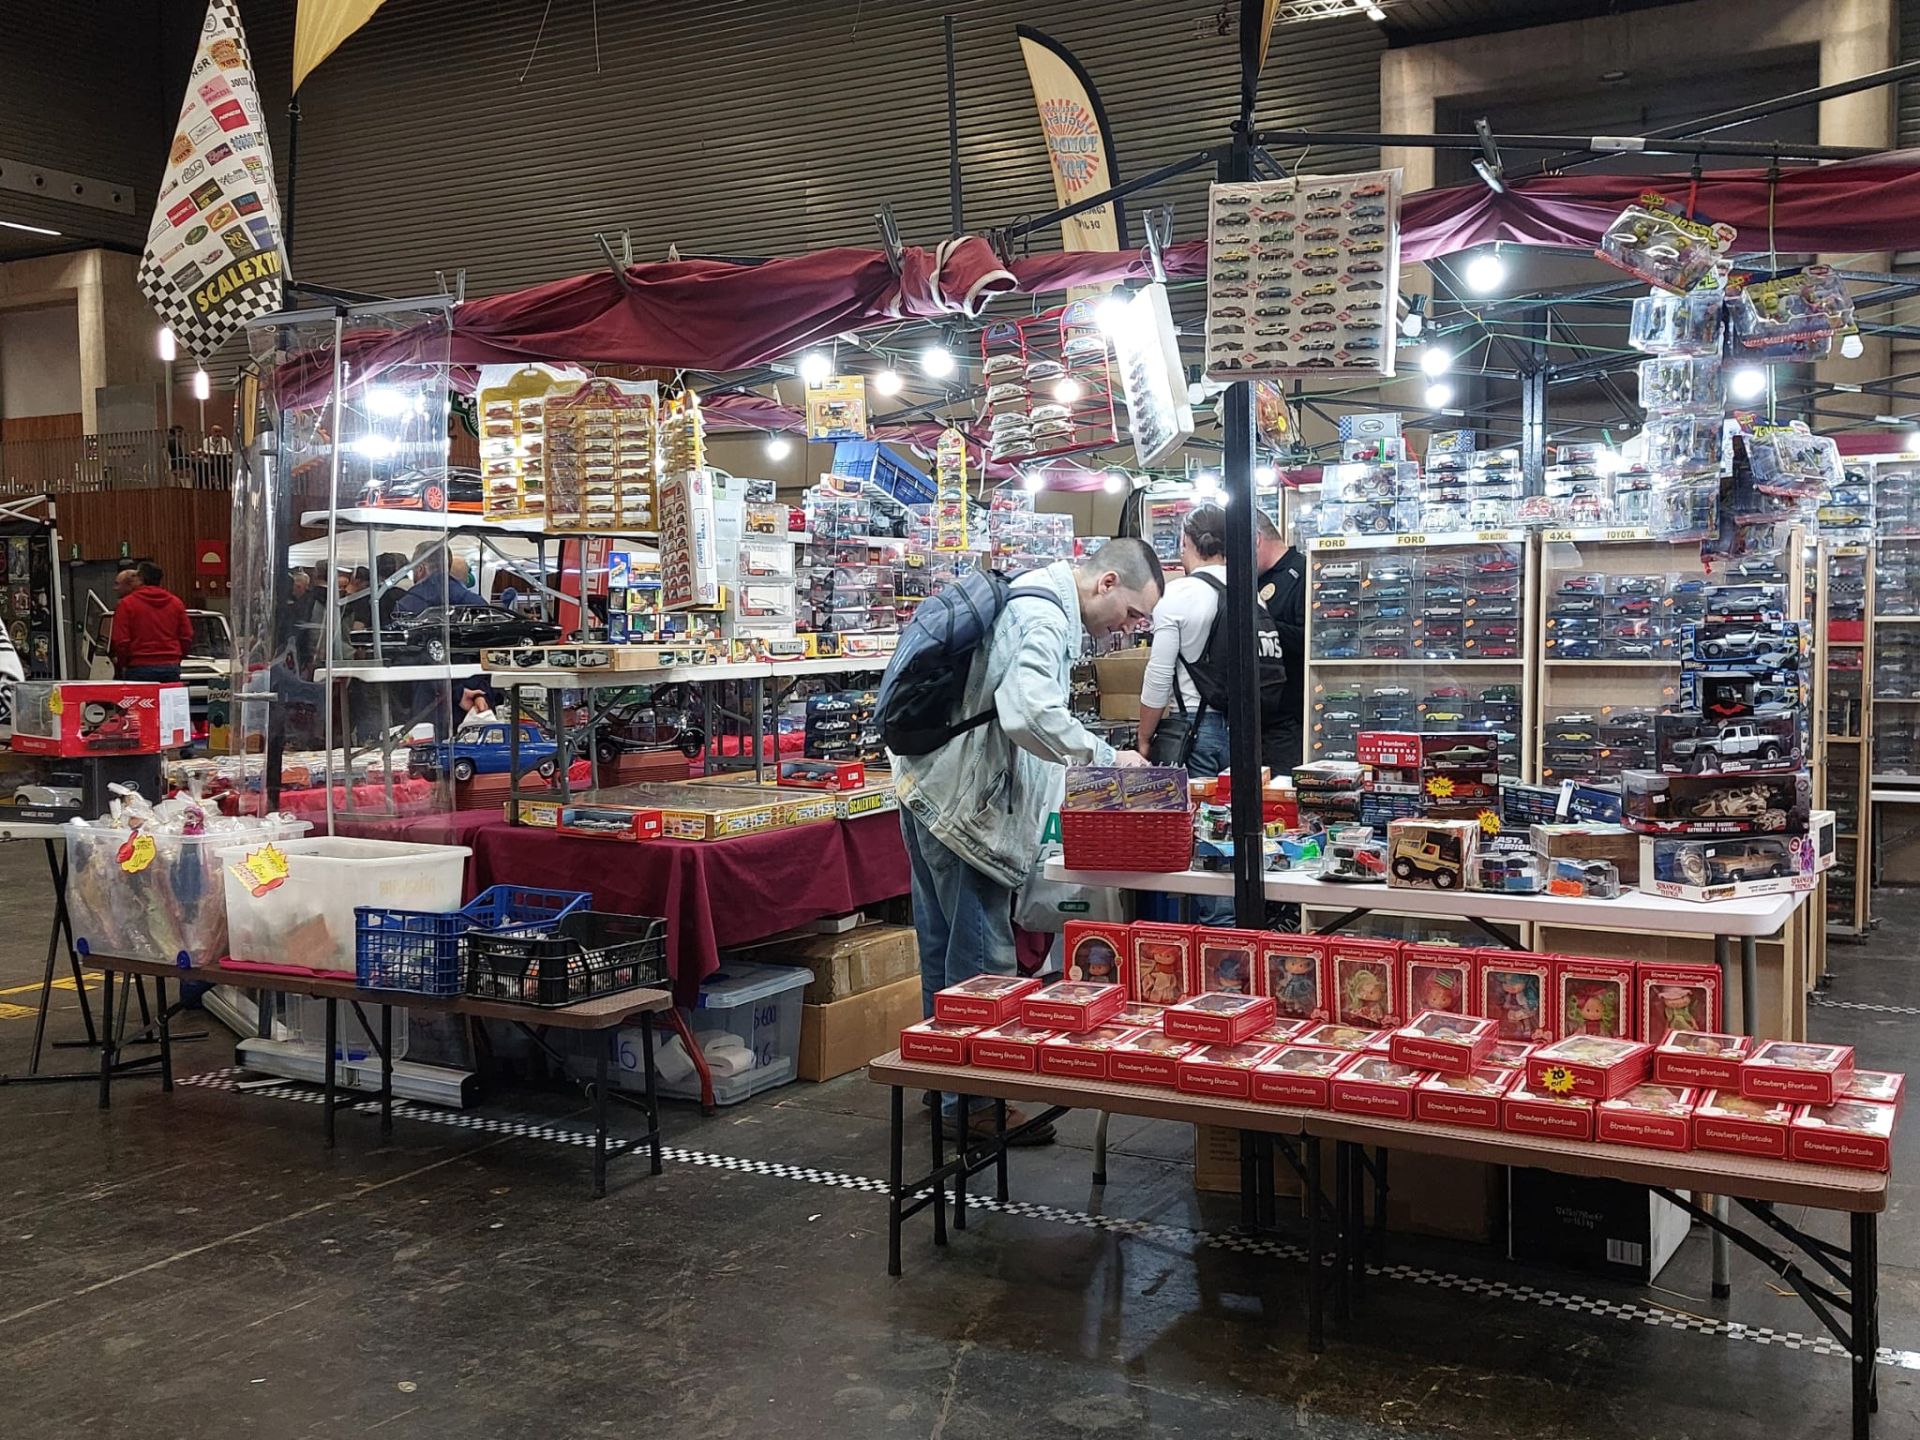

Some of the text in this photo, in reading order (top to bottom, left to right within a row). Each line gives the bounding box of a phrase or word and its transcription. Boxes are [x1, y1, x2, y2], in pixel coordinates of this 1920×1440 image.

[1397, 536, 1425, 544] FORD
[1550, 530, 1572, 540] 4X4
[1607, 530, 1635, 539] TOYOTA
[1319, 539, 1345, 548] FORD
[943, 1005, 988, 1015] Strawberry Shortcake
[1029, 1010, 1075, 1021] Strawberry Shortcake
[1173, 1022, 1221, 1033] Strawberry Shortcake
[909, 1043, 953, 1053] Strawberry Shortcake
[979, 1050, 1026, 1060] Strawberry Shortcake
[1402, 1046, 1459, 1062] Strawberry Shortcake
[1048, 1057, 1097, 1067] Strawberry Shortcake
[1118, 1063, 1168, 1074] Strawberry Shortcake
[1551, 1069, 1565, 1079] 20
[1667, 1064, 1730, 1078] Strawberry Shortcake
[1187, 1074, 1239, 1086] Strawberry Shortcake
[1753, 1078, 1818, 1091] Strawberry Shortcake
[1262, 1083, 1316, 1096] Strawberry Shortcake
[1342, 1092, 1399, 1105] Strawberry Shortcake
[1427, 1102, 1487, 1115] Strawberry Shortcake
[1515, 1113, 1577, 1127] Strawberry Shortcake
[1609, 1121, 1674, 1136] Strawberry Shortcake
[1706, 1128, 1773, 1144] Strawberry Shortcake
[1804, 1140, 1874, 1157] Strawberry Shortcake
